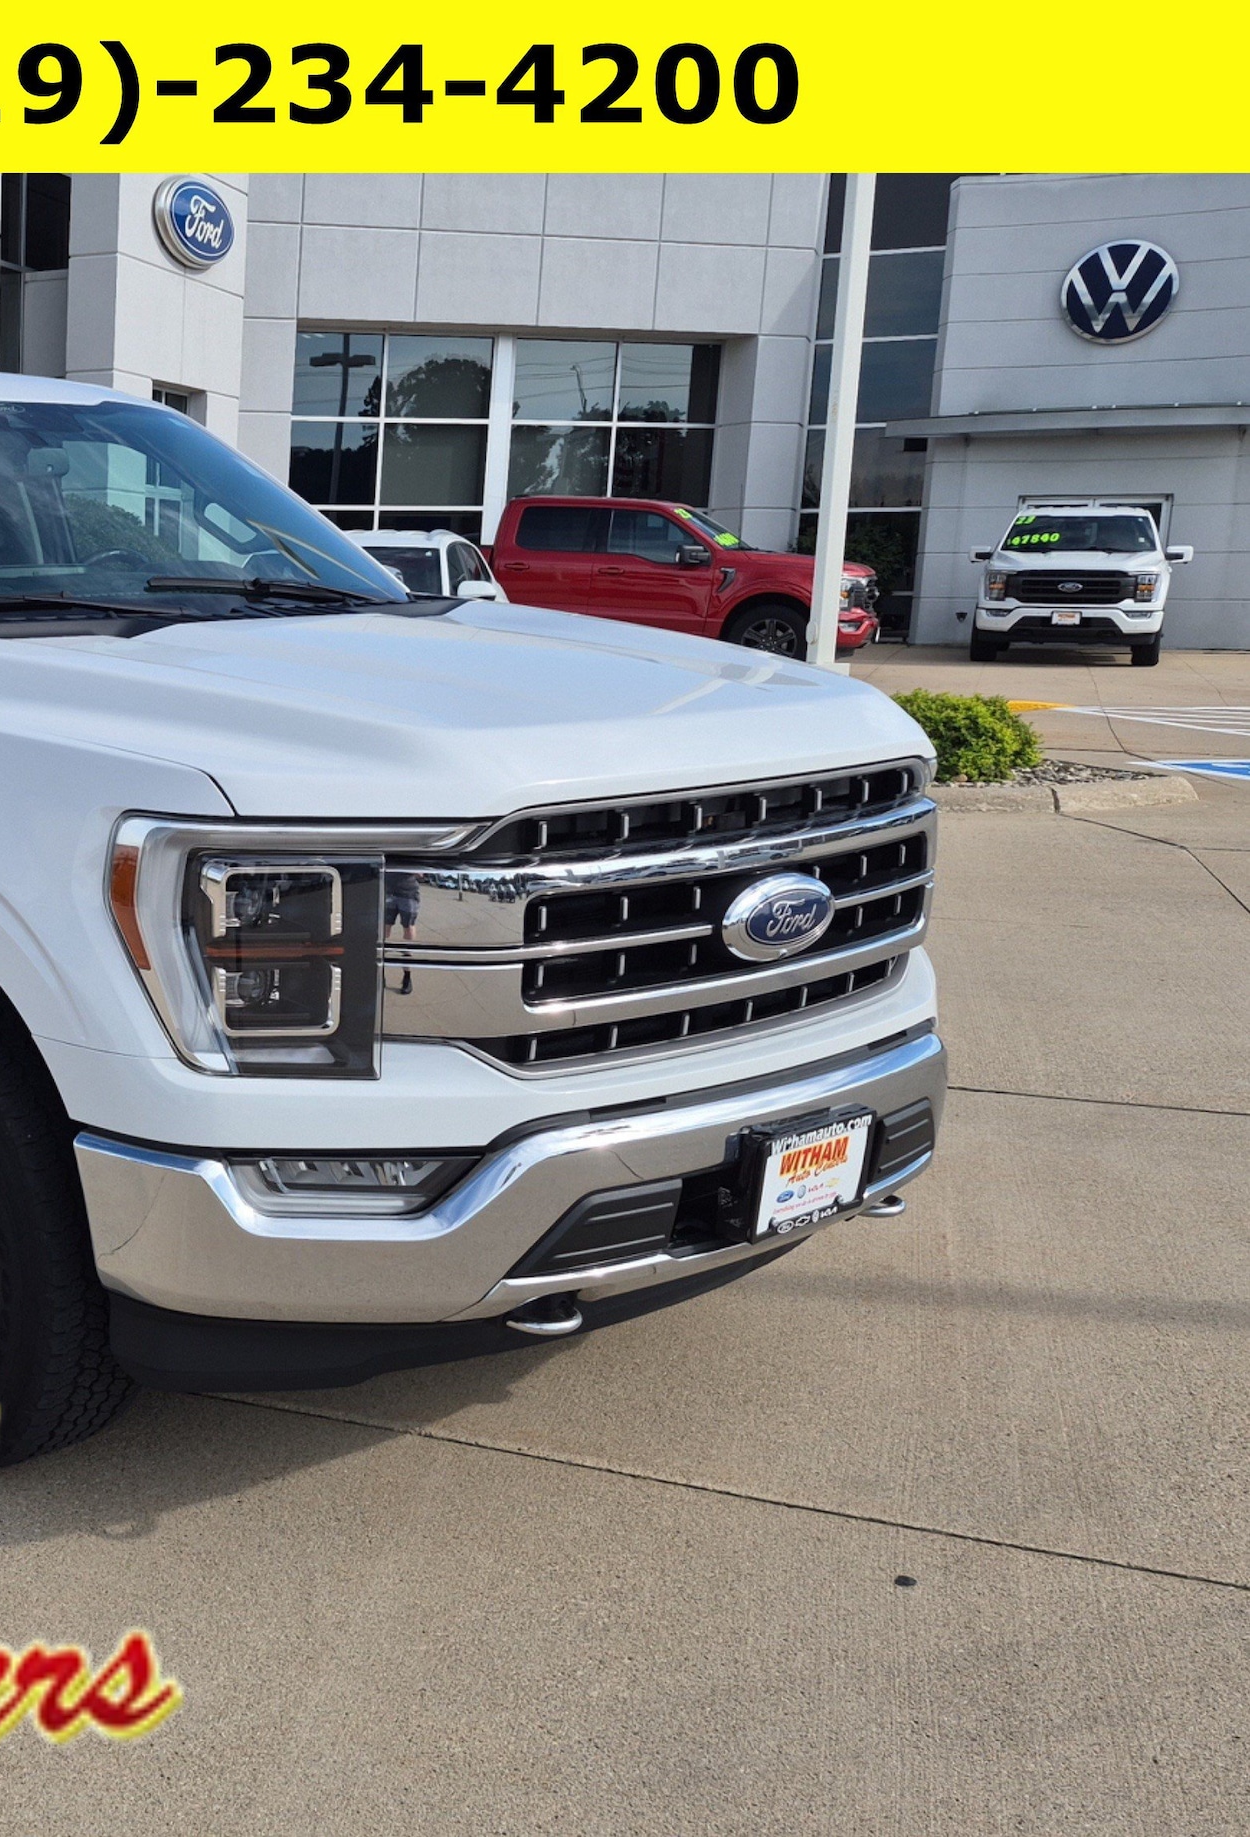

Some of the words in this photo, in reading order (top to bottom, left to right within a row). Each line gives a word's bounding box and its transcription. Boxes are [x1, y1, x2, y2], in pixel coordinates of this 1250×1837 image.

[184, 194, 225, 250] Ford
[1070, 244, 1173, 334] VW
[765, 898, 818, 938] Ford
[779, 1135, 851, 1178] WITHAM
